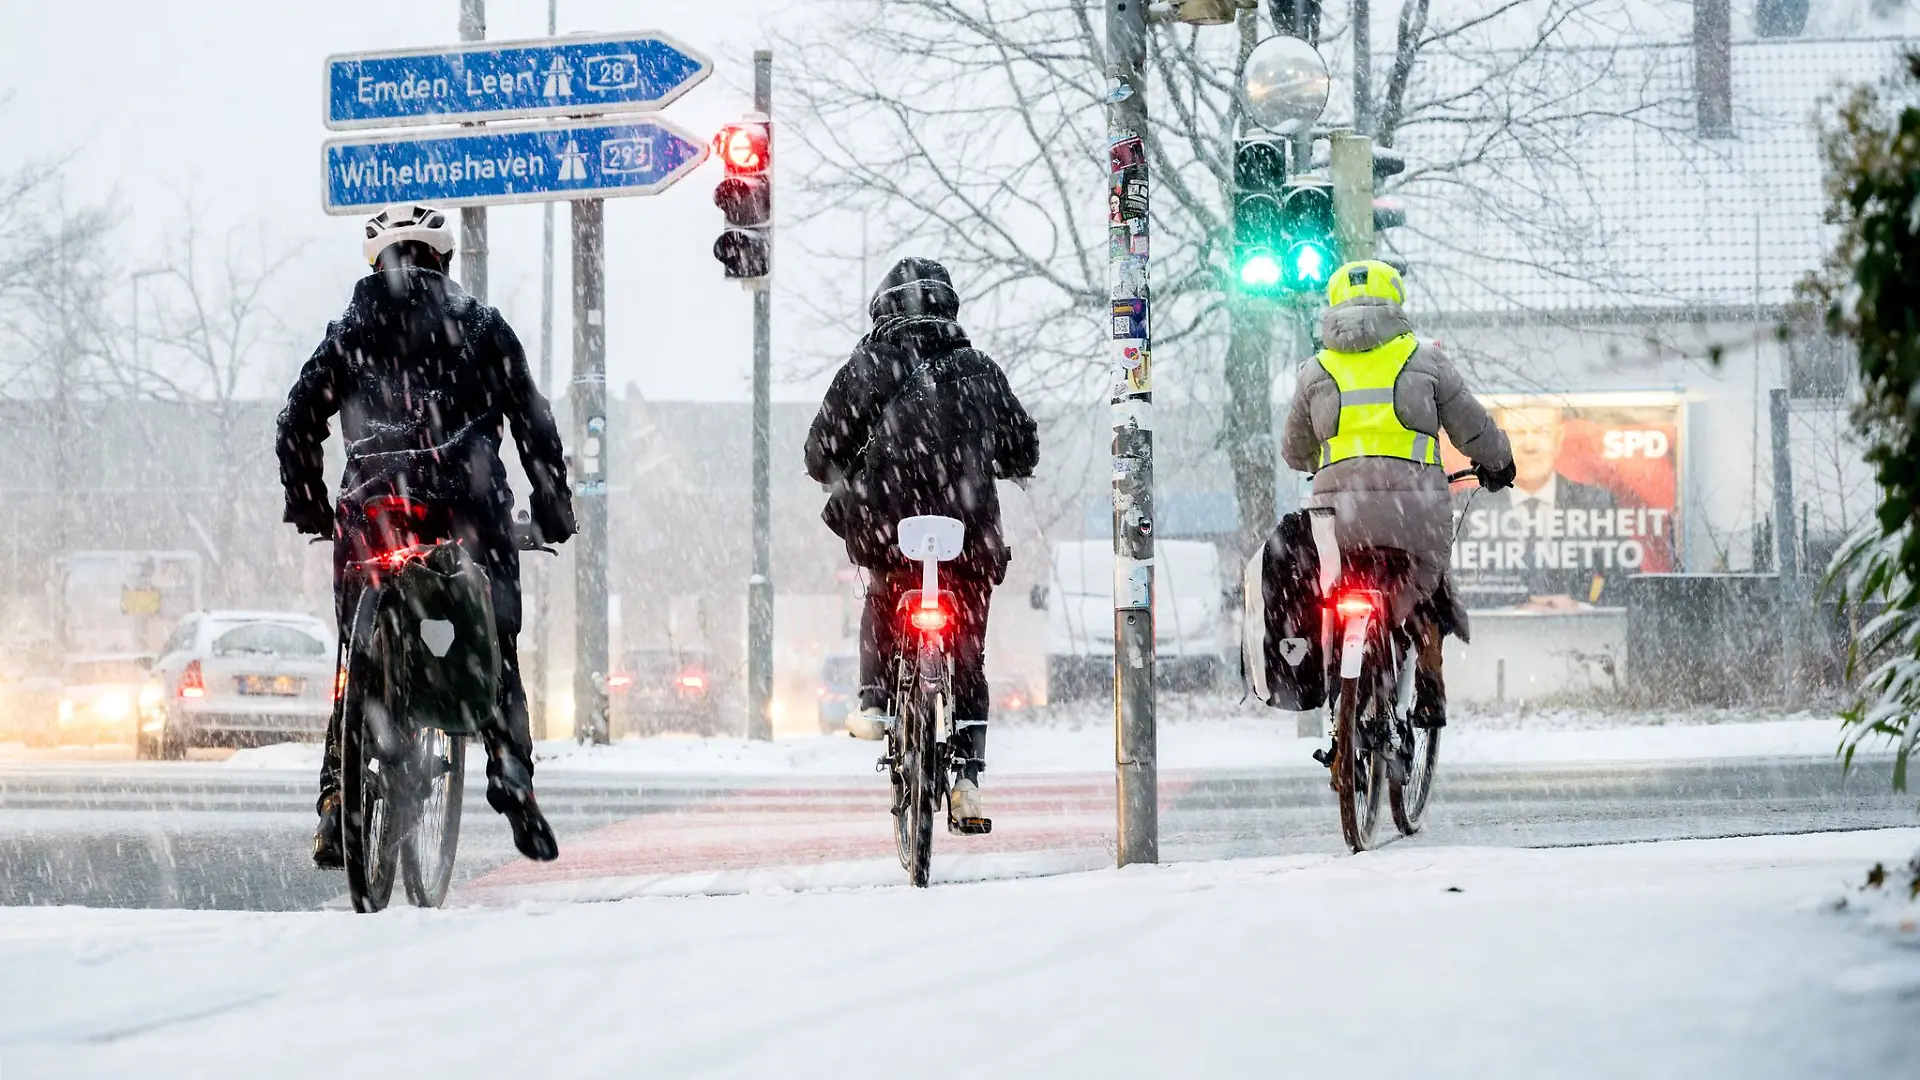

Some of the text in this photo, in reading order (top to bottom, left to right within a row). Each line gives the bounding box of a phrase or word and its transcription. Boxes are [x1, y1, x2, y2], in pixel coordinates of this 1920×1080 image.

[358, 69, 534, 103] Emden Leer
[599, 61, 625, 83] 28
[340, 153, 545, 189] Wilhelmshaven
[609, 144, 646, 168] 293
[1603, 429, 1669, 460] SPD
[1469, 508, 1668, 539] SICHERHEIT
[1535, 540, 1644, 570] NETTO
